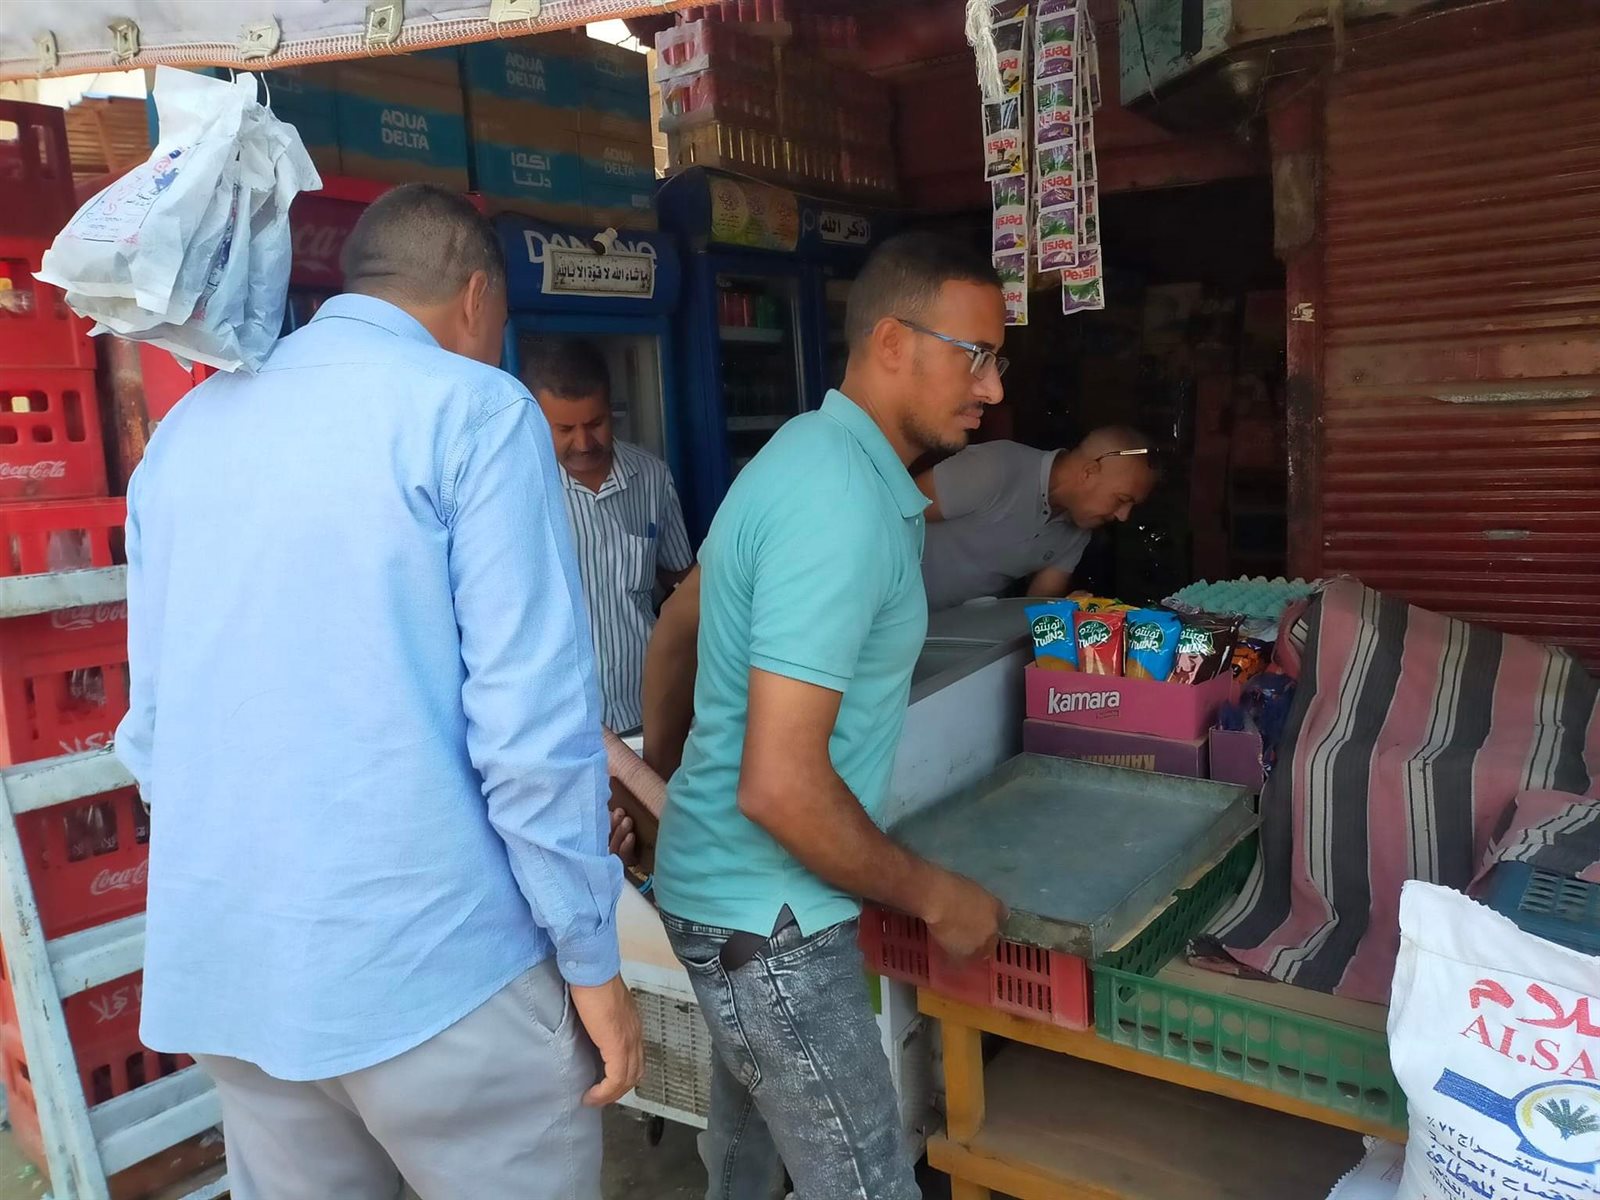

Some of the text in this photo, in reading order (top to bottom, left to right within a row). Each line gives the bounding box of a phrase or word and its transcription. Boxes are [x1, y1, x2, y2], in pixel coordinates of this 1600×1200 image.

[505, 52, 544, 74] AQUA
[998, 58, 1018, 70] Per
[506, 70, 546, 91] DELTA
[380, 110, 429, 132] AQUA
[381, 128, 430, 150] DELTA
[822, 216, 841, 232] الله
[995, 214, 1023, 229] Persil
[1042, 239, 1073, 254] Persil
[557, 264, 575, 282] بالله
[604, 268, 610, 279] لا
[612, 268, 624, 280] الله
[626, 267, 639, 281] شاء
[1064, 265, 1097, 282] Persil
[1048, 688, 1120, 714] kamara
